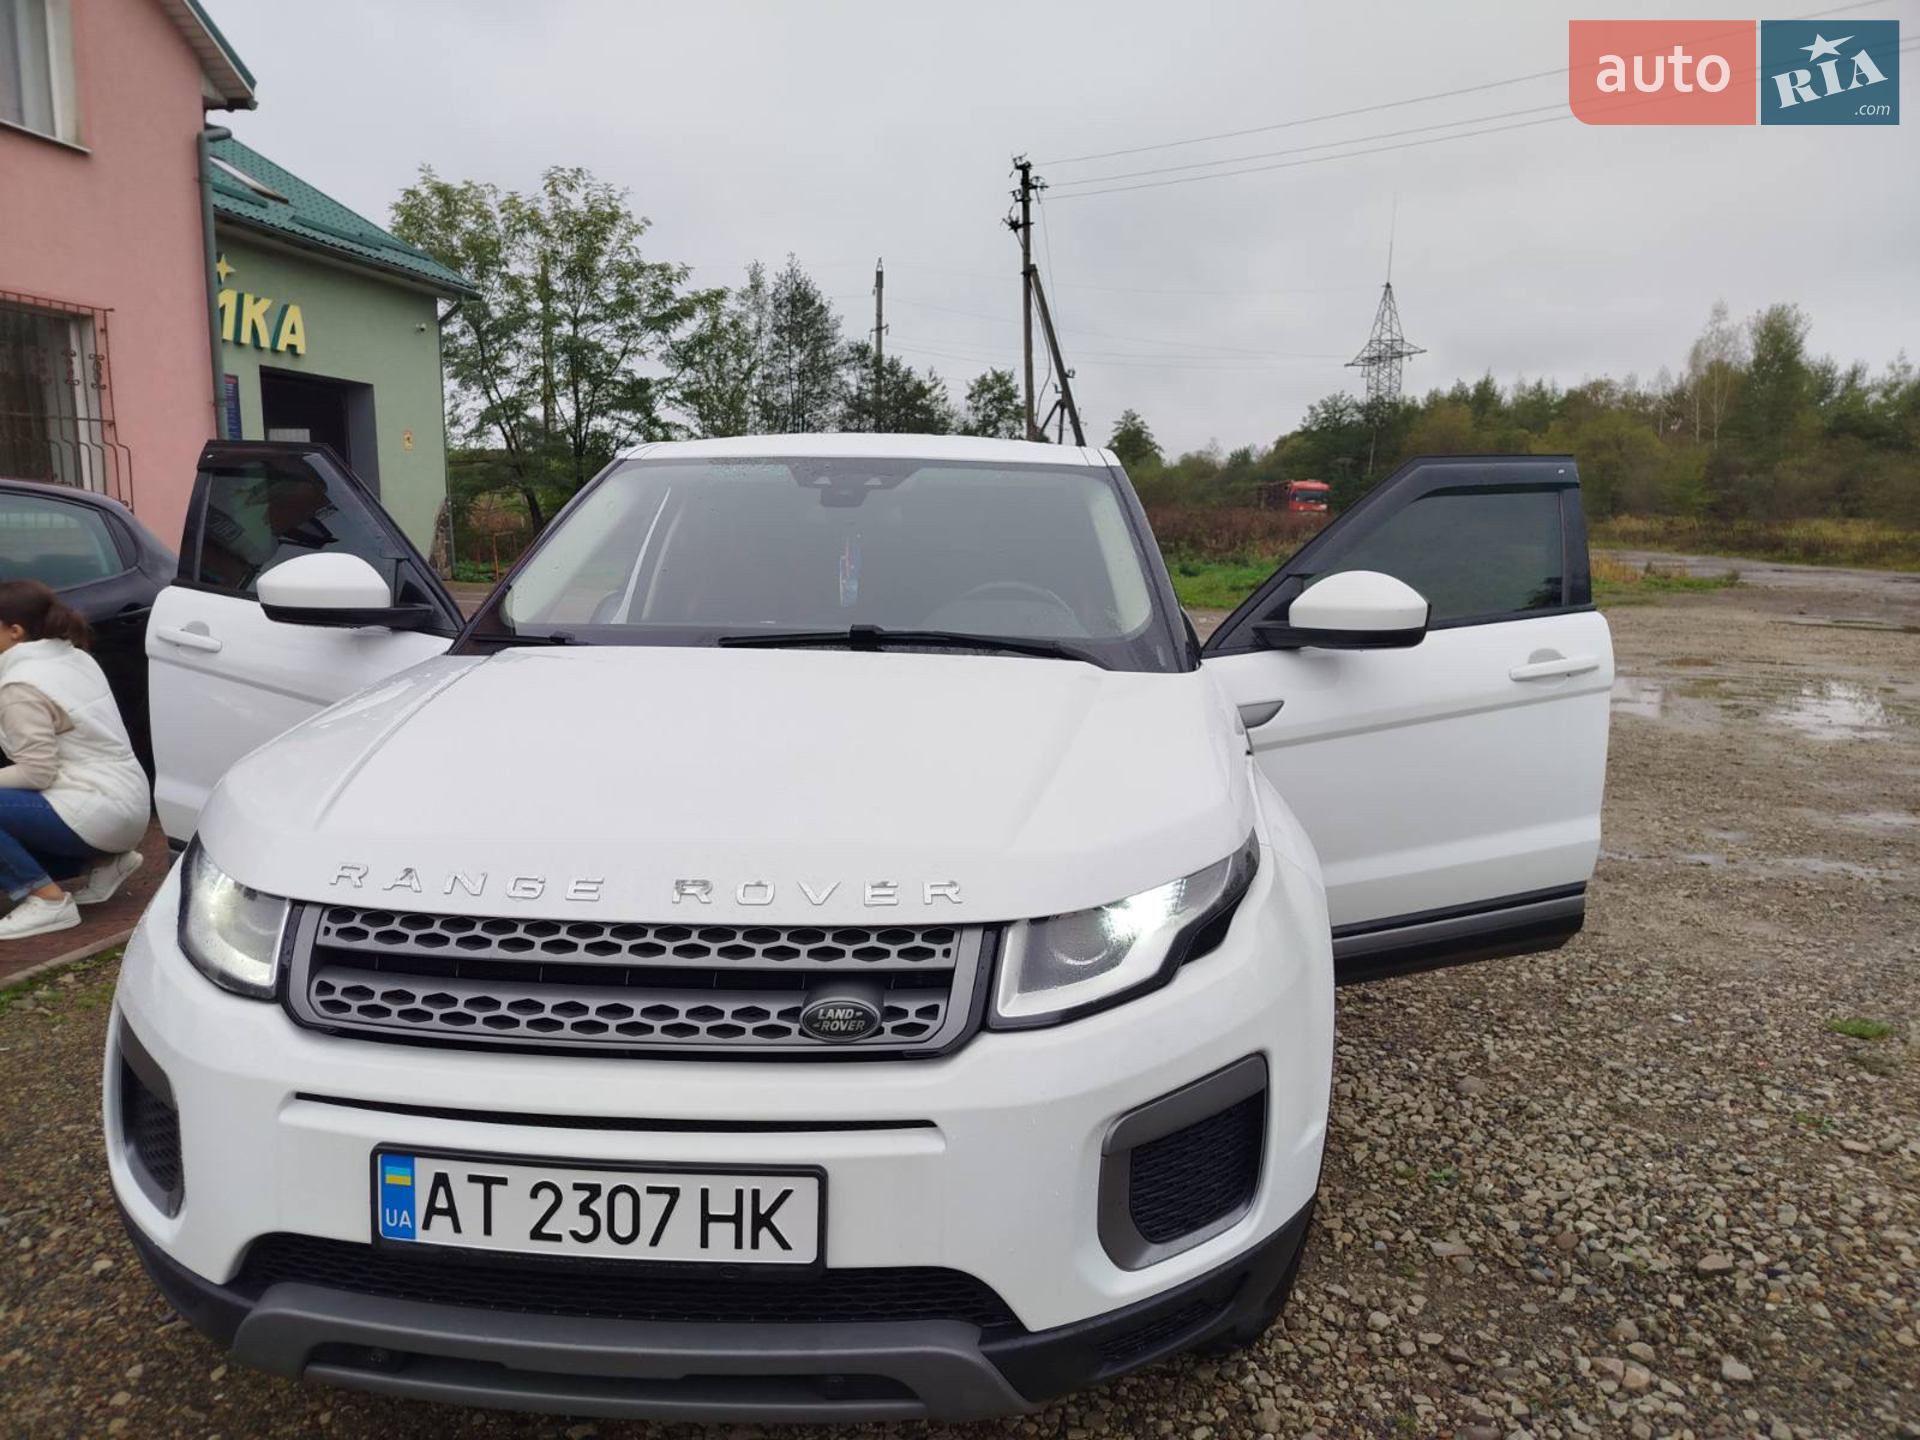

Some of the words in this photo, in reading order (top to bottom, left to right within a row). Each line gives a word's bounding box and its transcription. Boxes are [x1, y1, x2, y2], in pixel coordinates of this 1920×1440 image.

[329, 863, 605, 901] RANGE
[672, 879, 963, 907] ROVER
[818, 1008, 855, 1020] LAND
[820, 1020, 866, 1032] ROVER
[385, 1208, 413, 1229] UA
[422, 1171, 509, 1237] AT
[529, 1180, 681, 1247] 2307
[700, 1187, 794, 1251] HK
